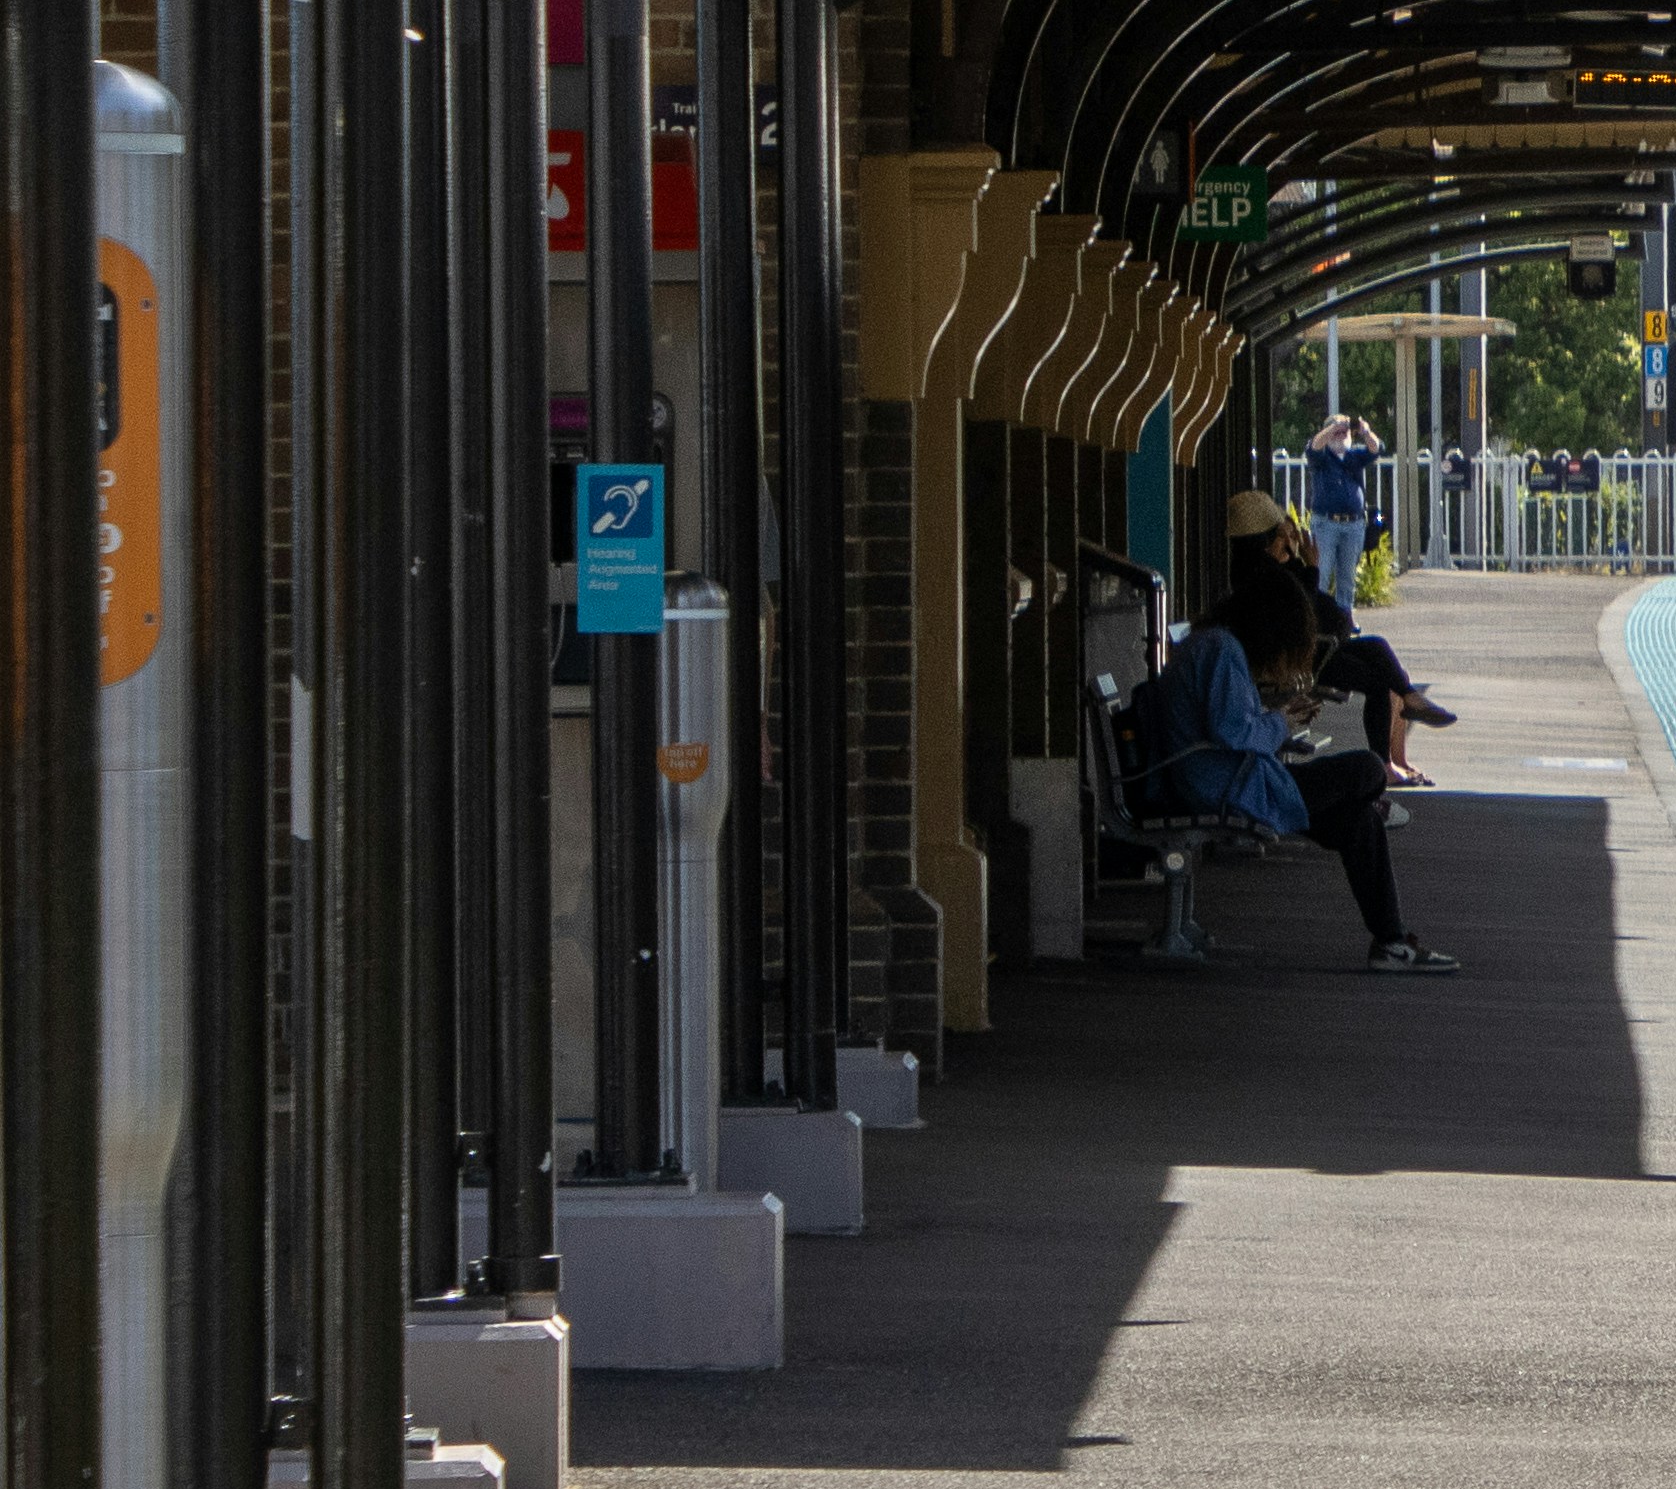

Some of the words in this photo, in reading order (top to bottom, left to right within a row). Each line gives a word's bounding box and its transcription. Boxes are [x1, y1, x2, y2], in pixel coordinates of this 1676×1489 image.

[1652, 315, 1662, 338] 8
[1652, 348, 1663, 373] 8
[1654, 380, 1664, 404] 9
[587, 548, 637, 561] Hearing
[588, 564, 658, 577] Augmented
[587, 579, 620, 591] Area
